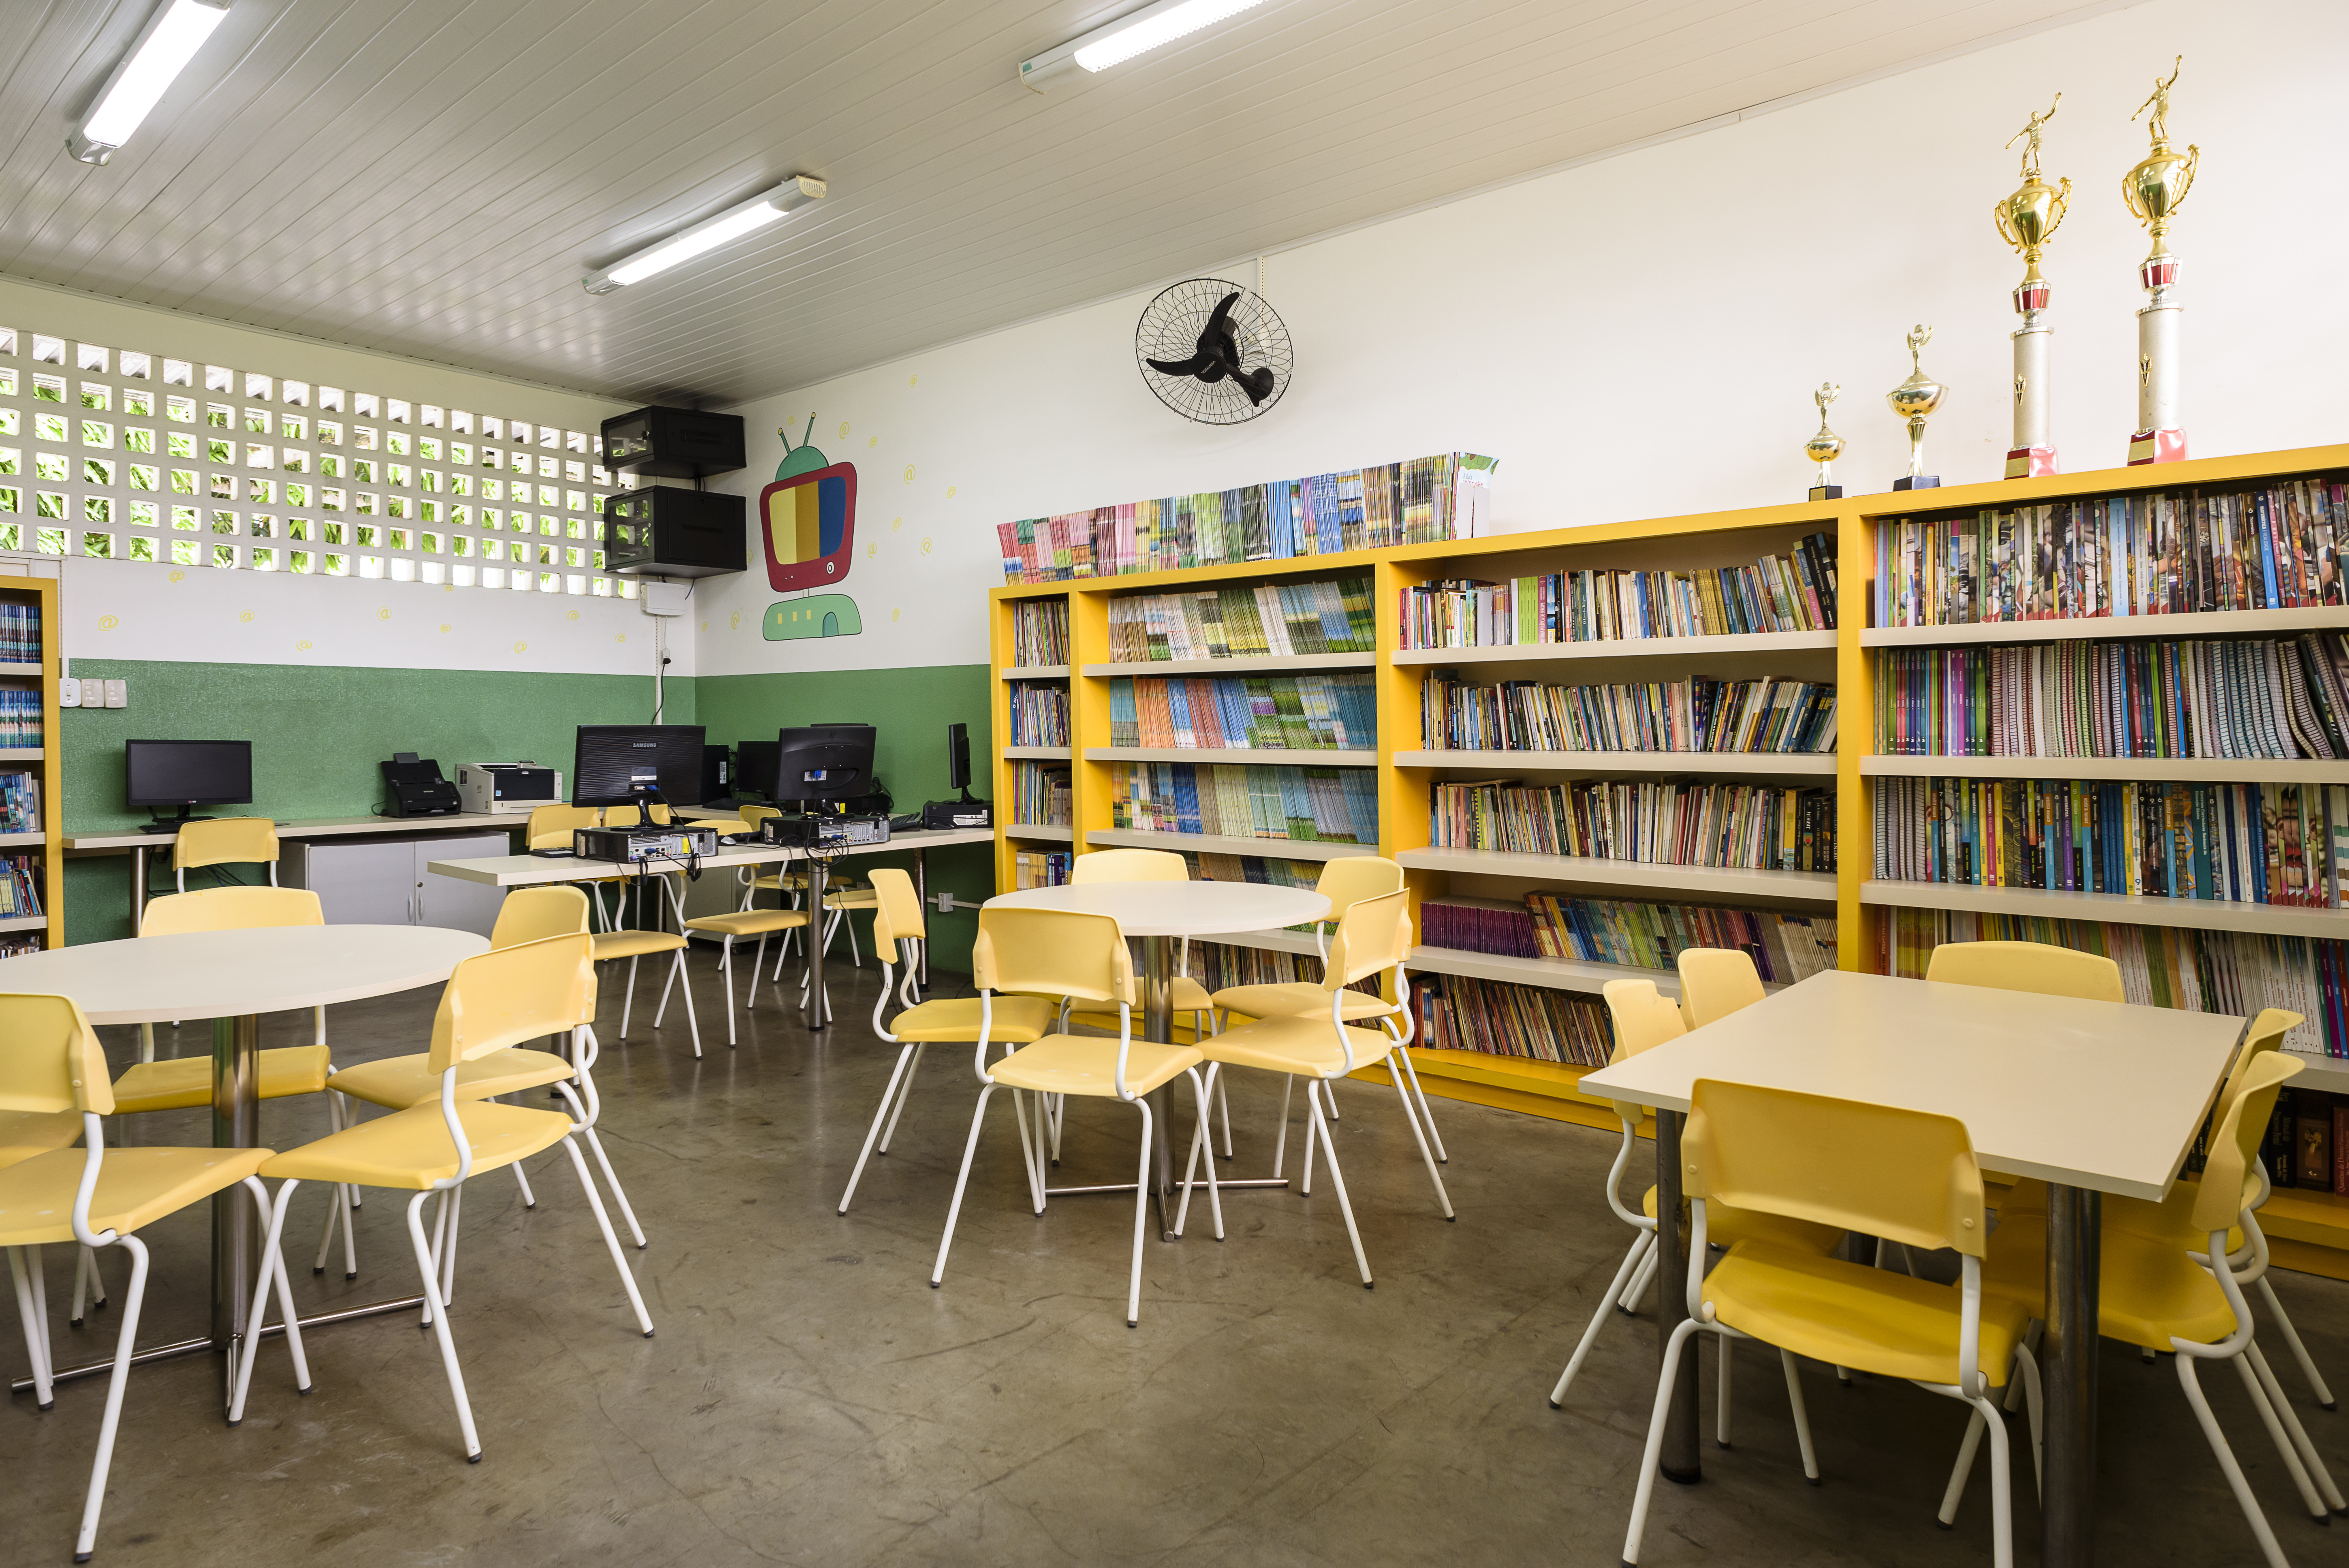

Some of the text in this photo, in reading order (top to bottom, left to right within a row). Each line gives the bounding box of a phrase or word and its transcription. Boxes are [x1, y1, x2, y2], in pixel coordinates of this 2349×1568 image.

[2283, 1117, 2291, 1135] Manual
[2273, 1132, 2281, 1145] Penal
[2338, 1173, 2346, 1192] Questões
